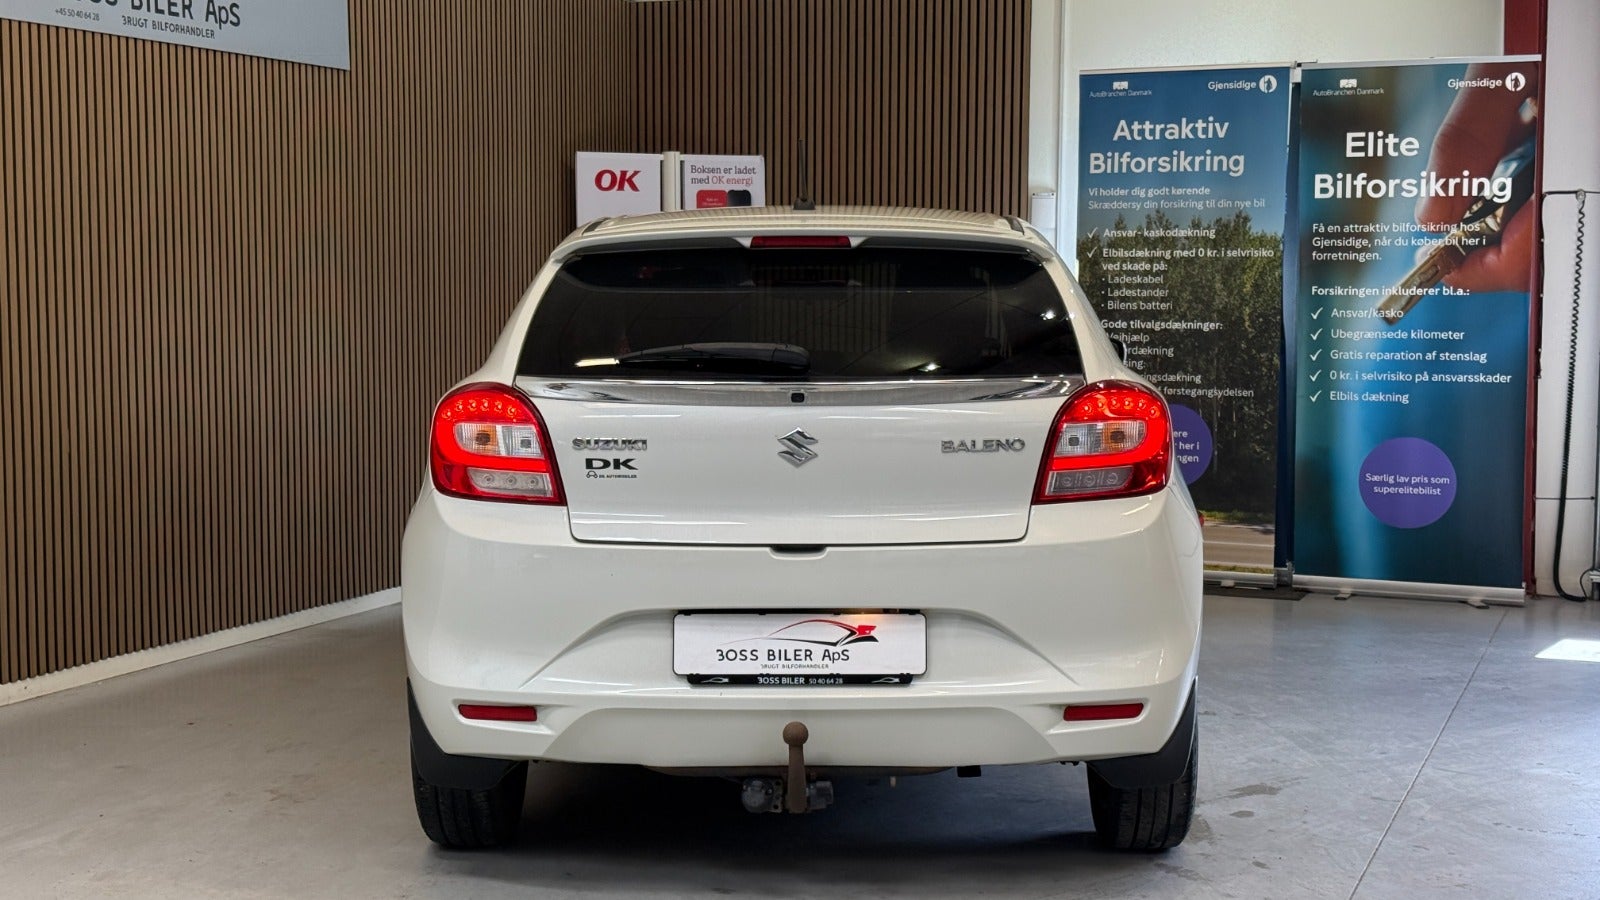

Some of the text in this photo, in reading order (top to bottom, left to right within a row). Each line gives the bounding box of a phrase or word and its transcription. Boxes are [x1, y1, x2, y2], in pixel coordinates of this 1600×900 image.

[67, 9, 75, 17] 50
[76, 10, 83, 18] 40
[84, 11, 91, 19] 64
[92, 12, 100, 21] 28
[152, 20, 216, 39] BILFORHANDLER
[1208, 79, 1257, 91] Gjensidige
[1448, 78, 1502, 92] Gjensidige
[1113, 116, 1229, 141] Attraktiv
[1346, 130, 1420, 158] Elite
[1090, 149, 1245, 177] Bilforsikring
[690, 165, 721, 174] Boksen
[734, 166, 756, 175] ladet
[595, 169, 641, 192] OK
[691, 175, 753, 187] med OK energi
[1314, 170, 1512, 203] Bilforsikring
[1088, 186, 1211, 198] Vi holder dig godt kørende
[1088, 199, 1265, 211] Skræddersy din forsikring til din nye bil
[1103, 228, 1216, 239] Ansvar- kaskodækning
[1312, 222, 1325, 232] Få
[1343, 223, 1389, 233] attraktiv
[1392, 222, 1457, 234] bilforsikring
[1460, 222, 1480, 232] hos
[1312, 236, 1486, 248] Gjensidige, når du køber bil her i
[1102, 248, 1274, 259] Elbilsdækning med 0 kr. i selvrisiko
[1312, 251, 1382, 262] forretningen.
[1102, 261, 1168, 273] ved skade på:
[1107, 275, 1164, 284] Ladeskabel
[1107, 288, 1169, 297] Ladestander
[1311, 286, 1470, 297] Forsikringen inkluderer bl.a.:
[1107, 301, 1173, 310] Bilens batteri
[1331, 308, 1404, 319] Ansvar/kasko
[1100, 319, 1223, 332] Gode tilvalgsdækninger:
[1331, 329, 1465, 340] Ubegrænsede kilometer
[1127, 346, 1175, 357] rdækning
[1330, 350, 1488, 363] Gratis reparation af stenslag
[1123, 359, 1146, 370] sing:
[1330, 370, 1512, 384] 0 kr. i selvrisiko på ansvarsskader
[1163, 387, 1254, 398] førstegangsydelsen
[1330, 391, 1409, 404] Elbils dækning
[572, 438, 647, 451] SUZUKI
[941, 438, 1025, 453] BALENO
[1179, 441, 1195, 450] her
[585, 458, 638, 470] DK
[1365, 473, 1394, 483] Særlig
[1396, 474, 1409, 483] lav
[1411, 475, 1429, 484] pris
[1373, 485, 1441, 495] superelitebilist
[767, 649, 813, 661] BILER
[821, 649, 849, 663] ApS
[781, 676, 805, 684] BILER
